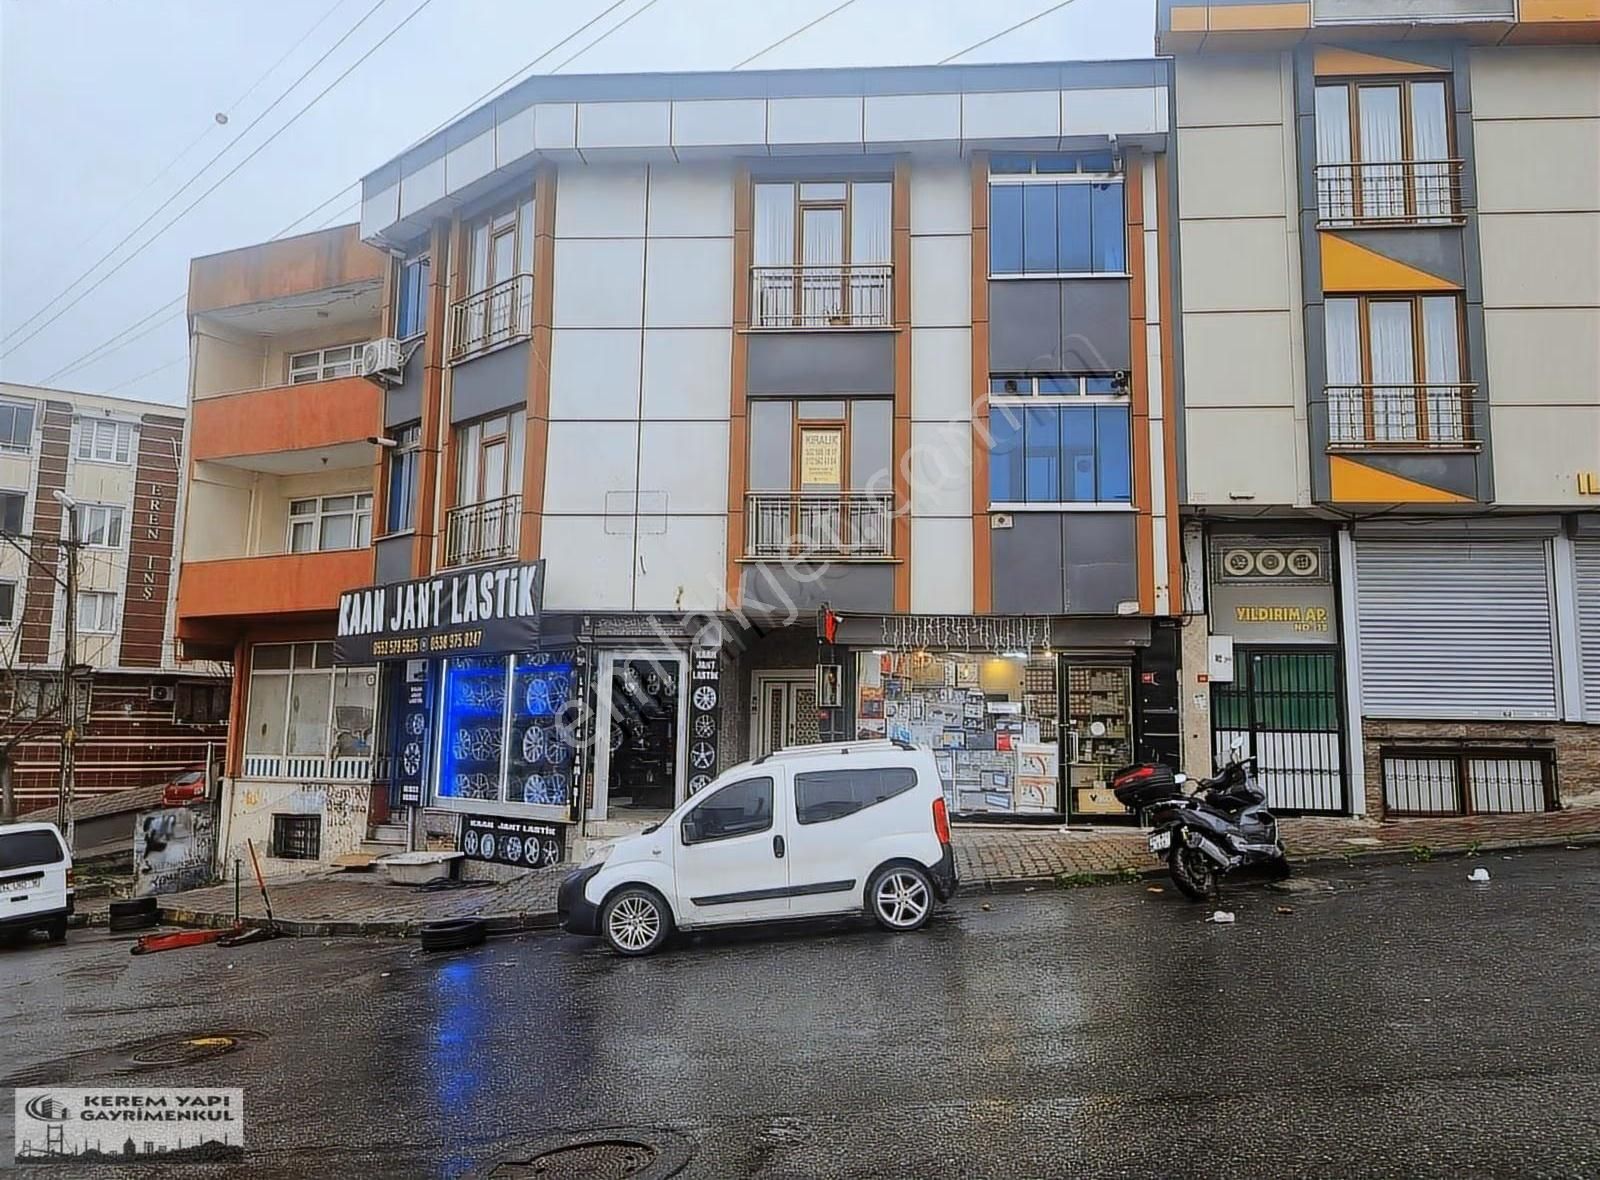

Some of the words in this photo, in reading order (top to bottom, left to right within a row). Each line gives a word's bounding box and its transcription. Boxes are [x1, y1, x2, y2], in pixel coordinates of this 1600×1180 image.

[147, 484, 163, 540] EREN
[337, 589, 386, 637] KAAN
[390, 580, 444, 631] JANT
[451, 565, 537, 624] LASTİK
[1236, 607, 1302, 621] YILDIRIM
